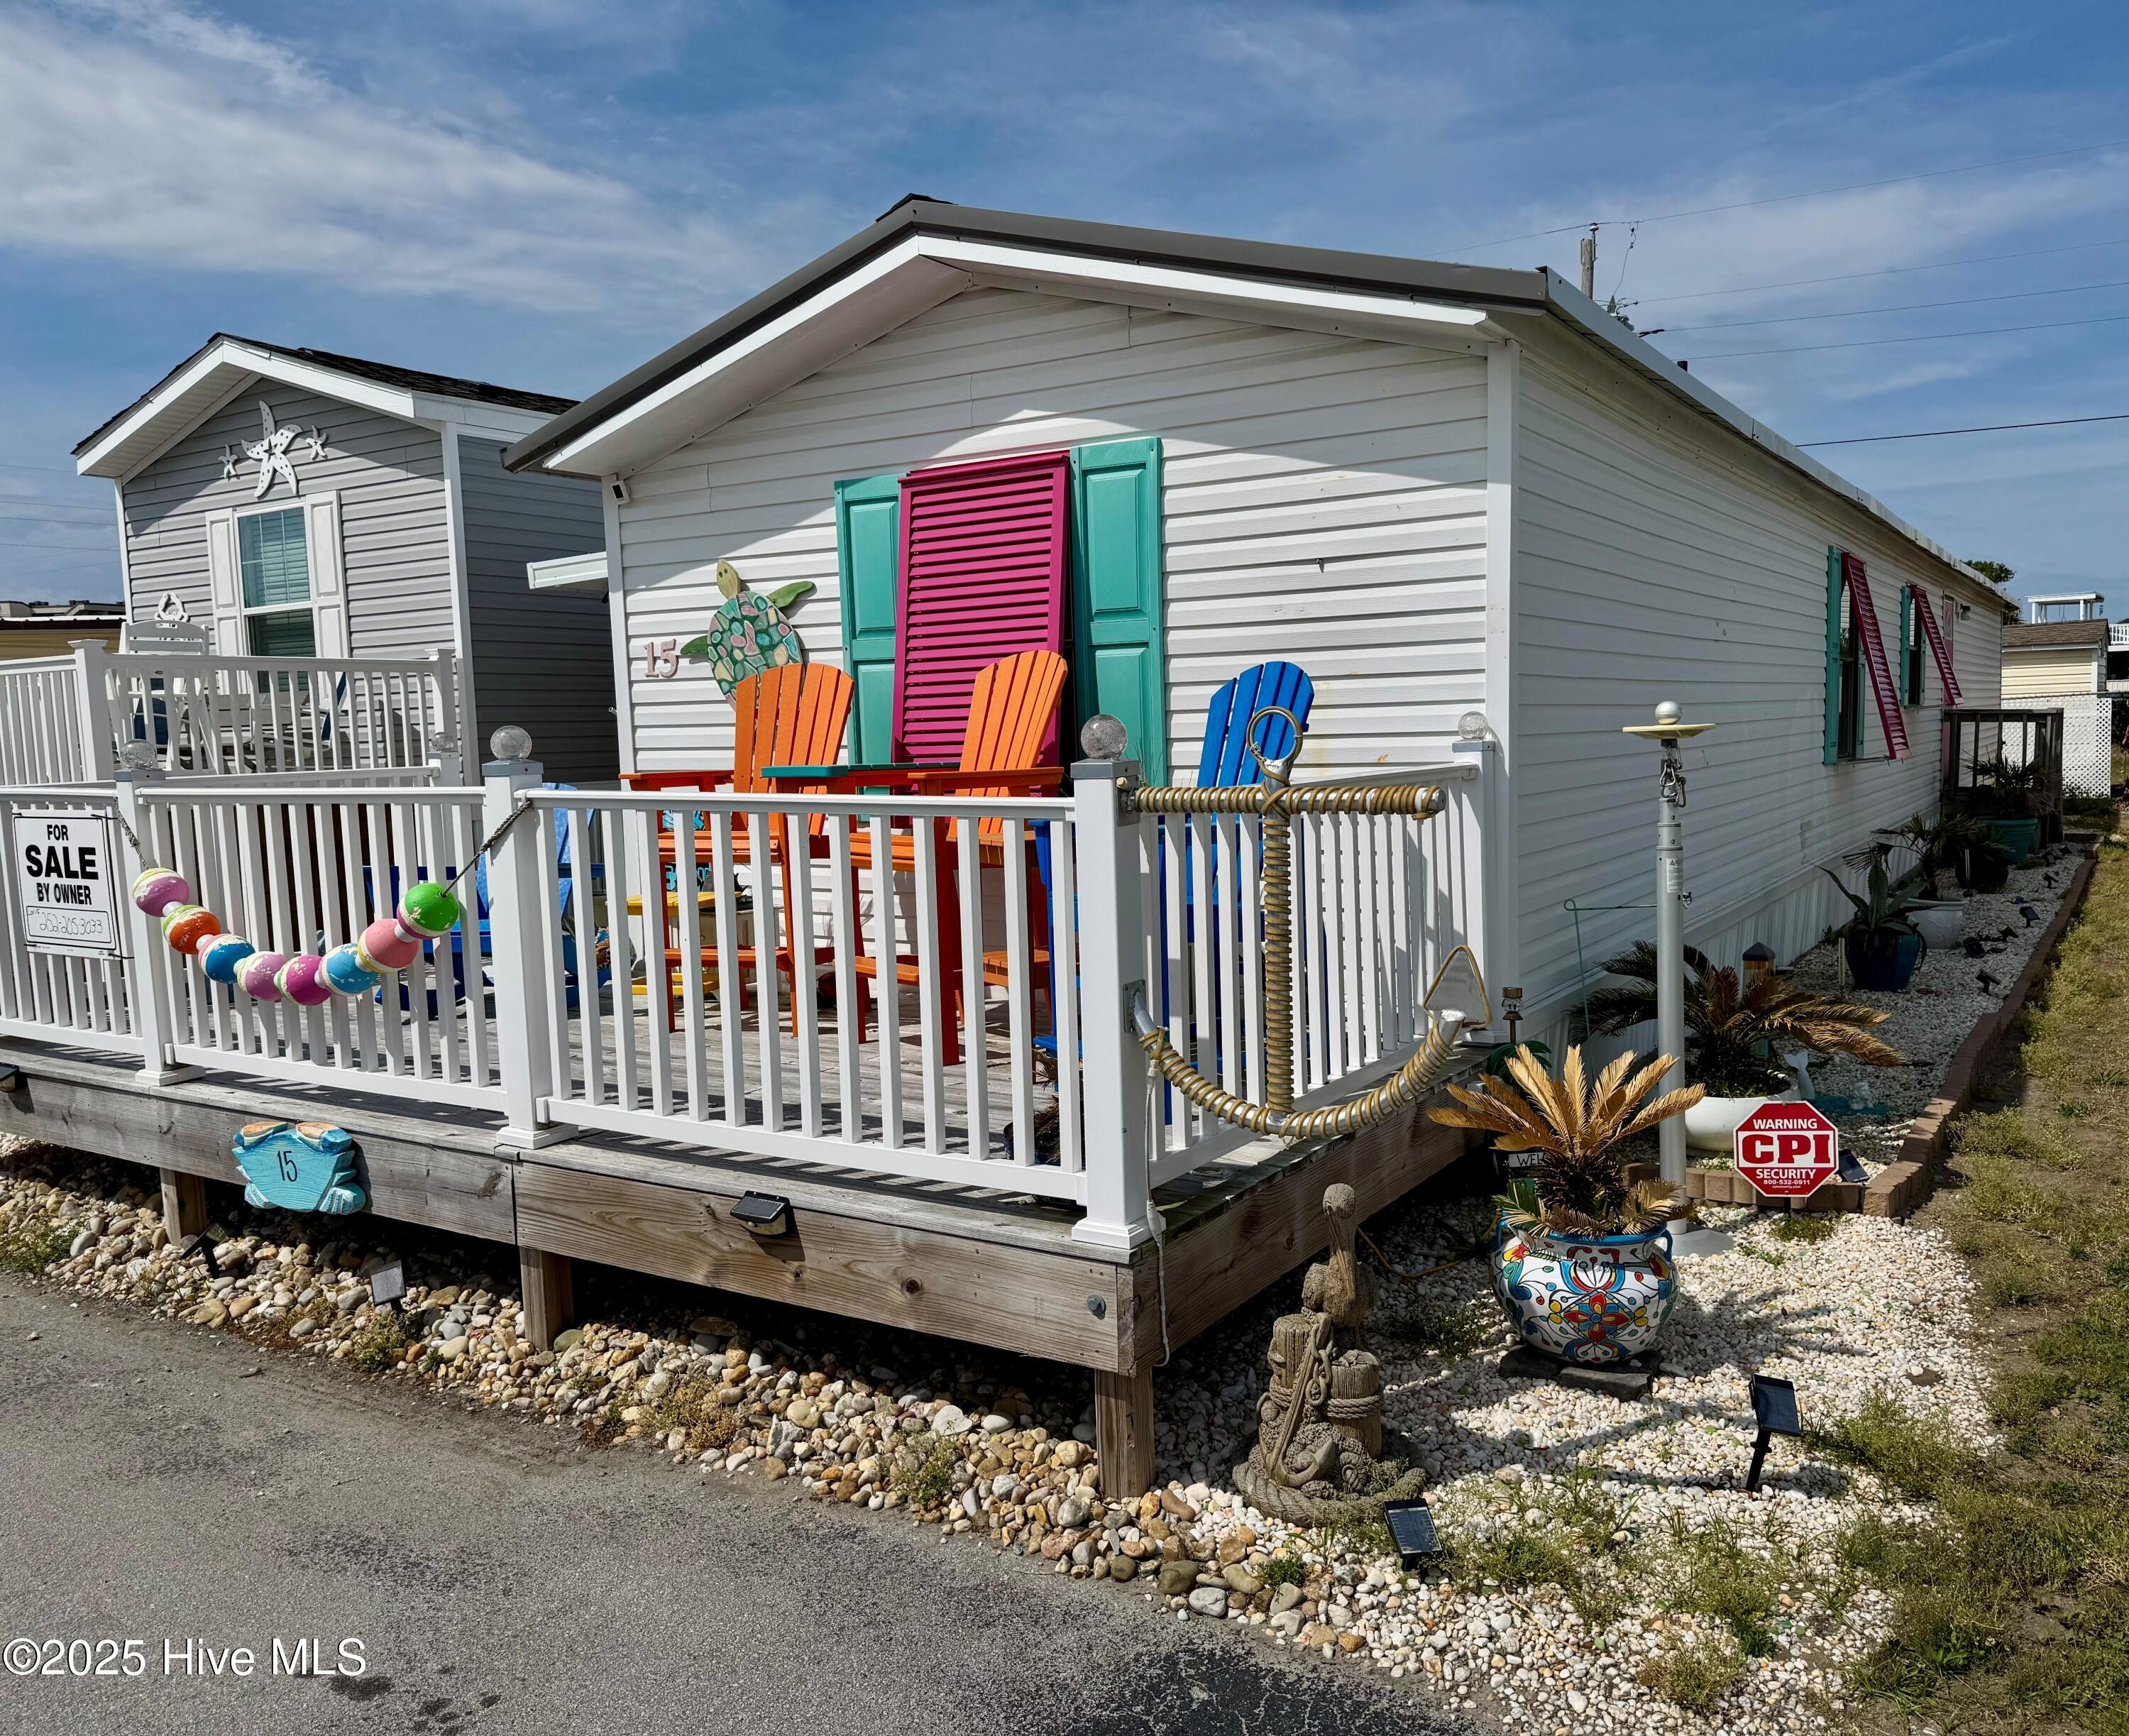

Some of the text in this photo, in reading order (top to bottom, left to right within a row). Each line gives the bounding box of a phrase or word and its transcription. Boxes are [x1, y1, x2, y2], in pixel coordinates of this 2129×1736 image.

[644, 639, 679, 679] 15
[46, 824, 69, 841] FOR
[25, 844, 99, 880] SALE
[36, 882, 92, 906] BY OWNER
[1753, 1119, 1817, 1130] WARNING
[1742, 1134, 1831, 1164] CPI
[277, 1150, 298, 1182] 15
[1756, 1169, 1817, 1179] SECURITY
